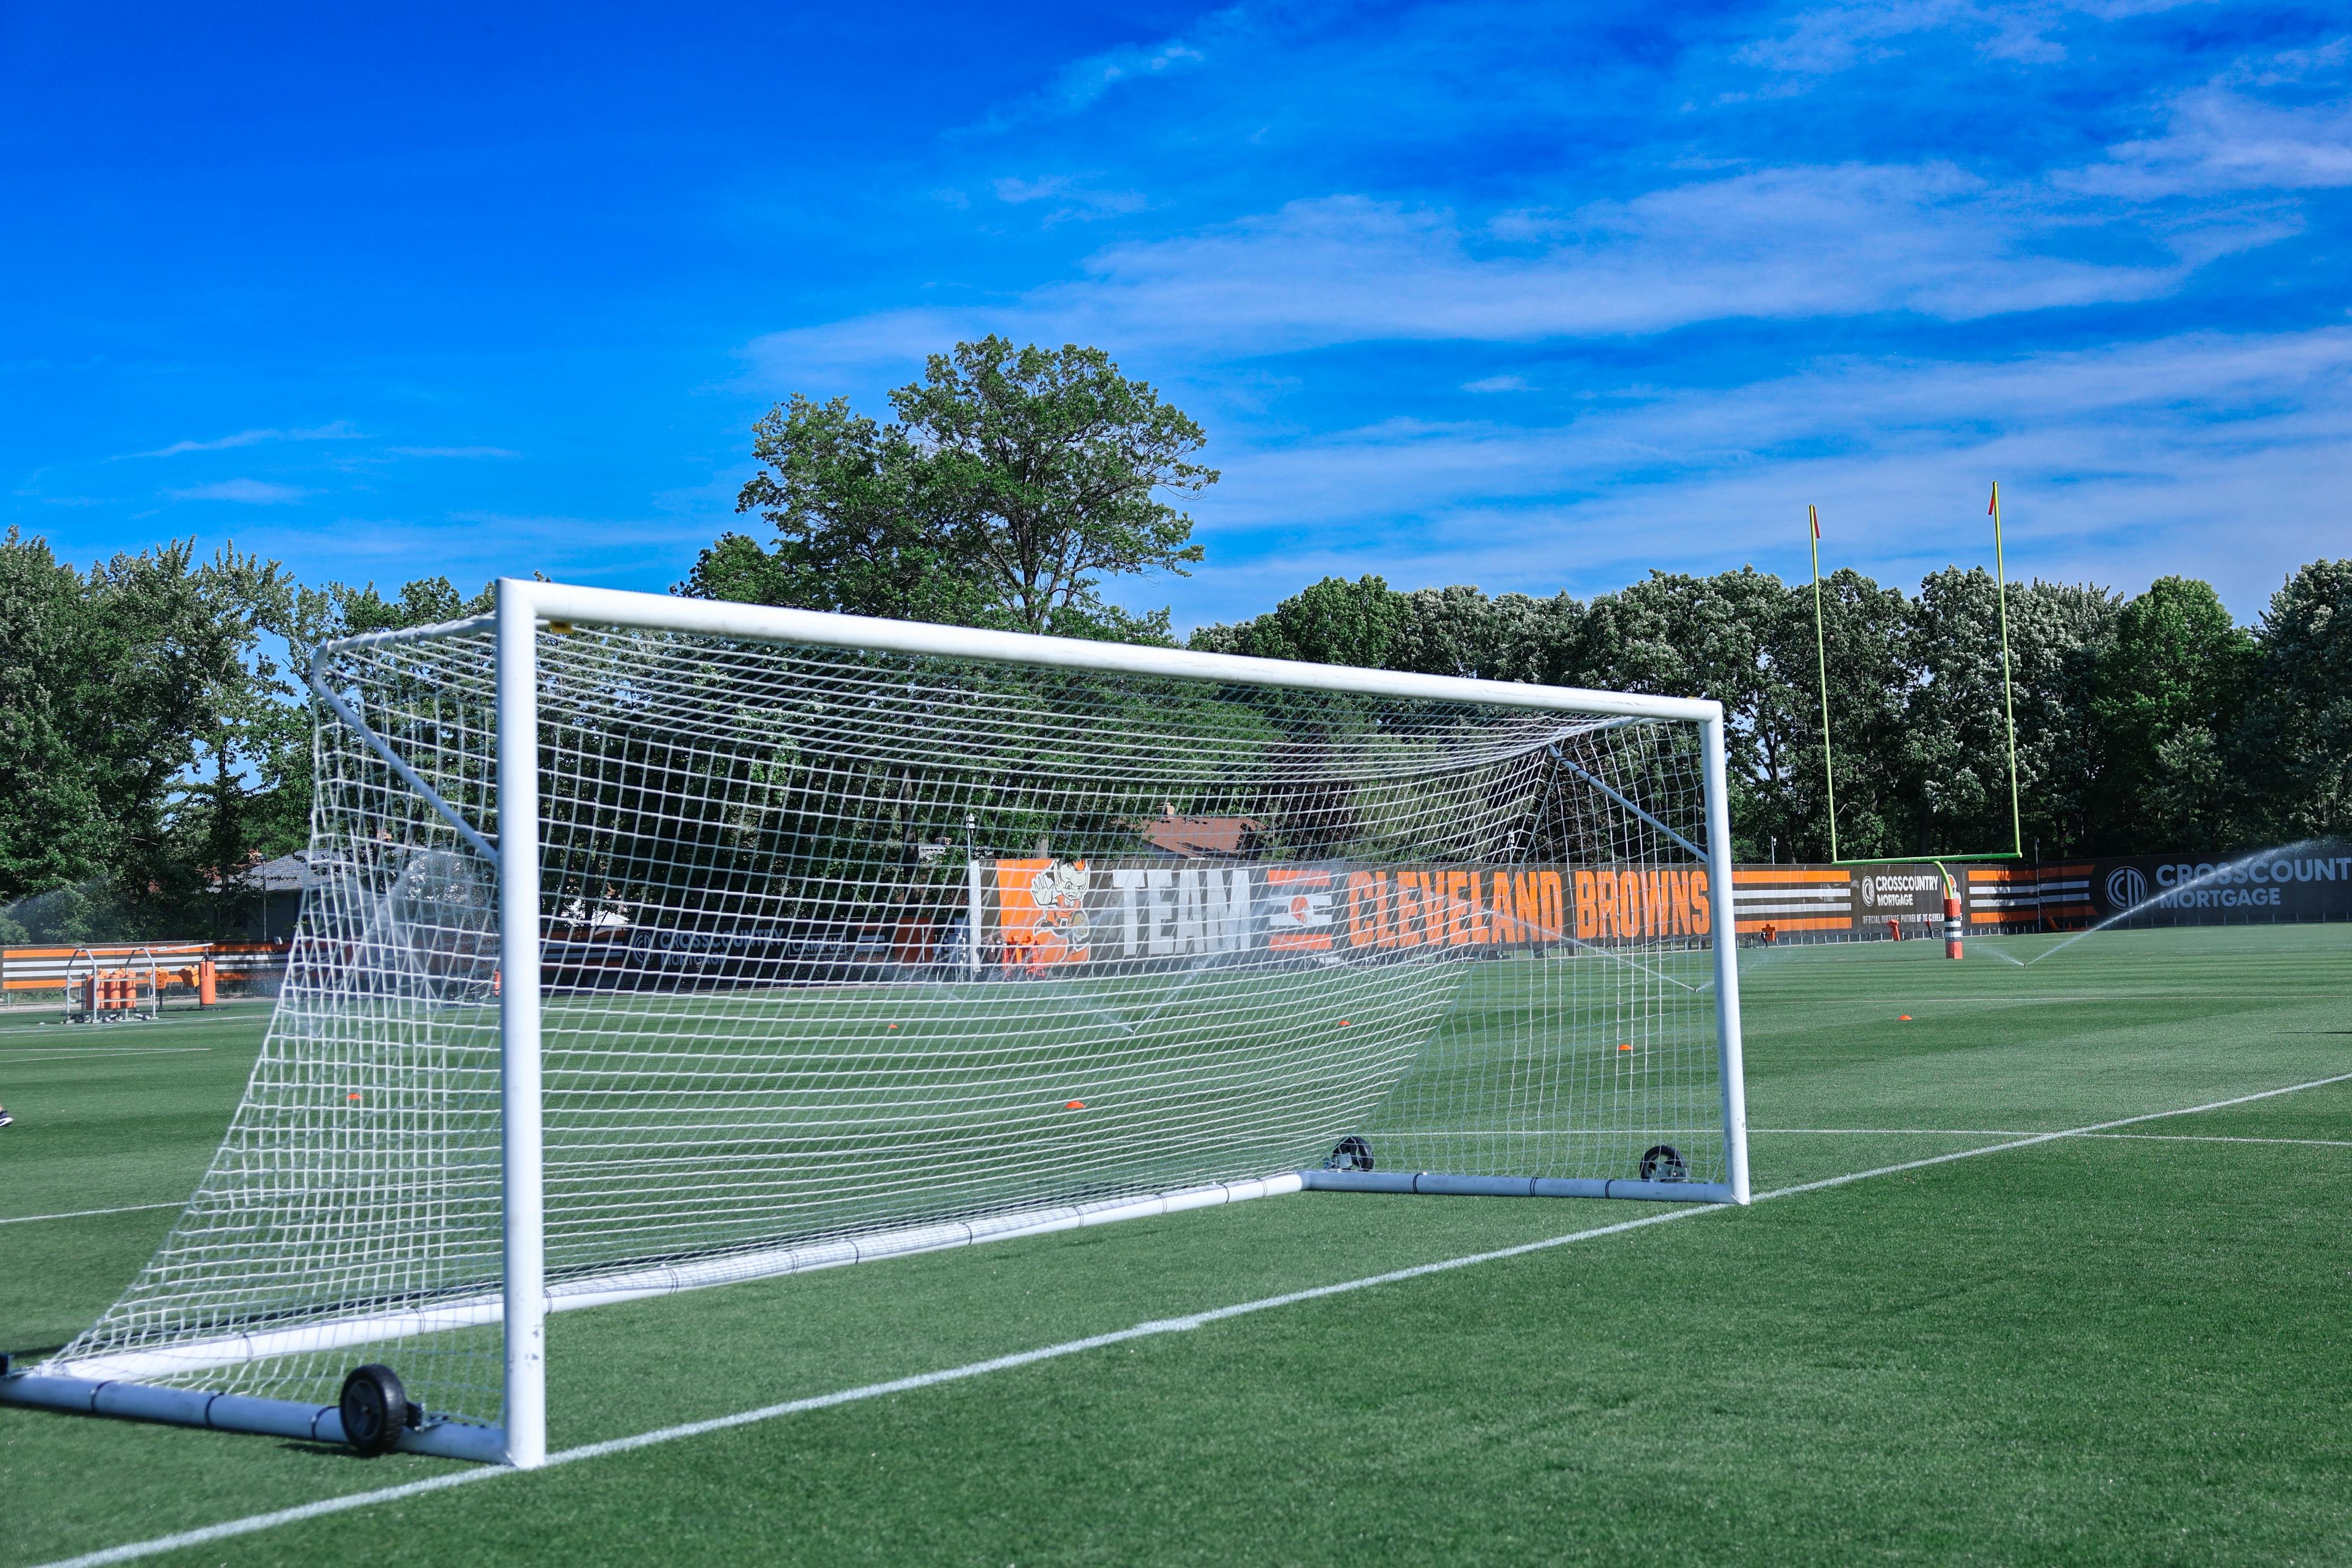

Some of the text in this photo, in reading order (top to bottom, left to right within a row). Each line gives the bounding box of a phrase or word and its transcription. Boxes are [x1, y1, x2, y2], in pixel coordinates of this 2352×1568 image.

[1875, 876, 1938, 891] CROSSCOUNTRY
[1877, 894, 1913, 906] MORTGAGE
[2159, 887, 2281, 909] MORTGAGE
[1113, 869, 1251, 955] TEAM
[1348, 870, 1711, 948] CLEVELAND BROWNS
[1862, 915, 1881, 924] OFFICIAL
[1900, 914, 1916, 922] PARTNER
[1916, 913, 1922, 922] OF
[659, 928, 784, 950] CROSSCOUNTRY
[792, 937, 844, 952] CAMPUS
[660, 951, 727, 967] MORTGAGE
